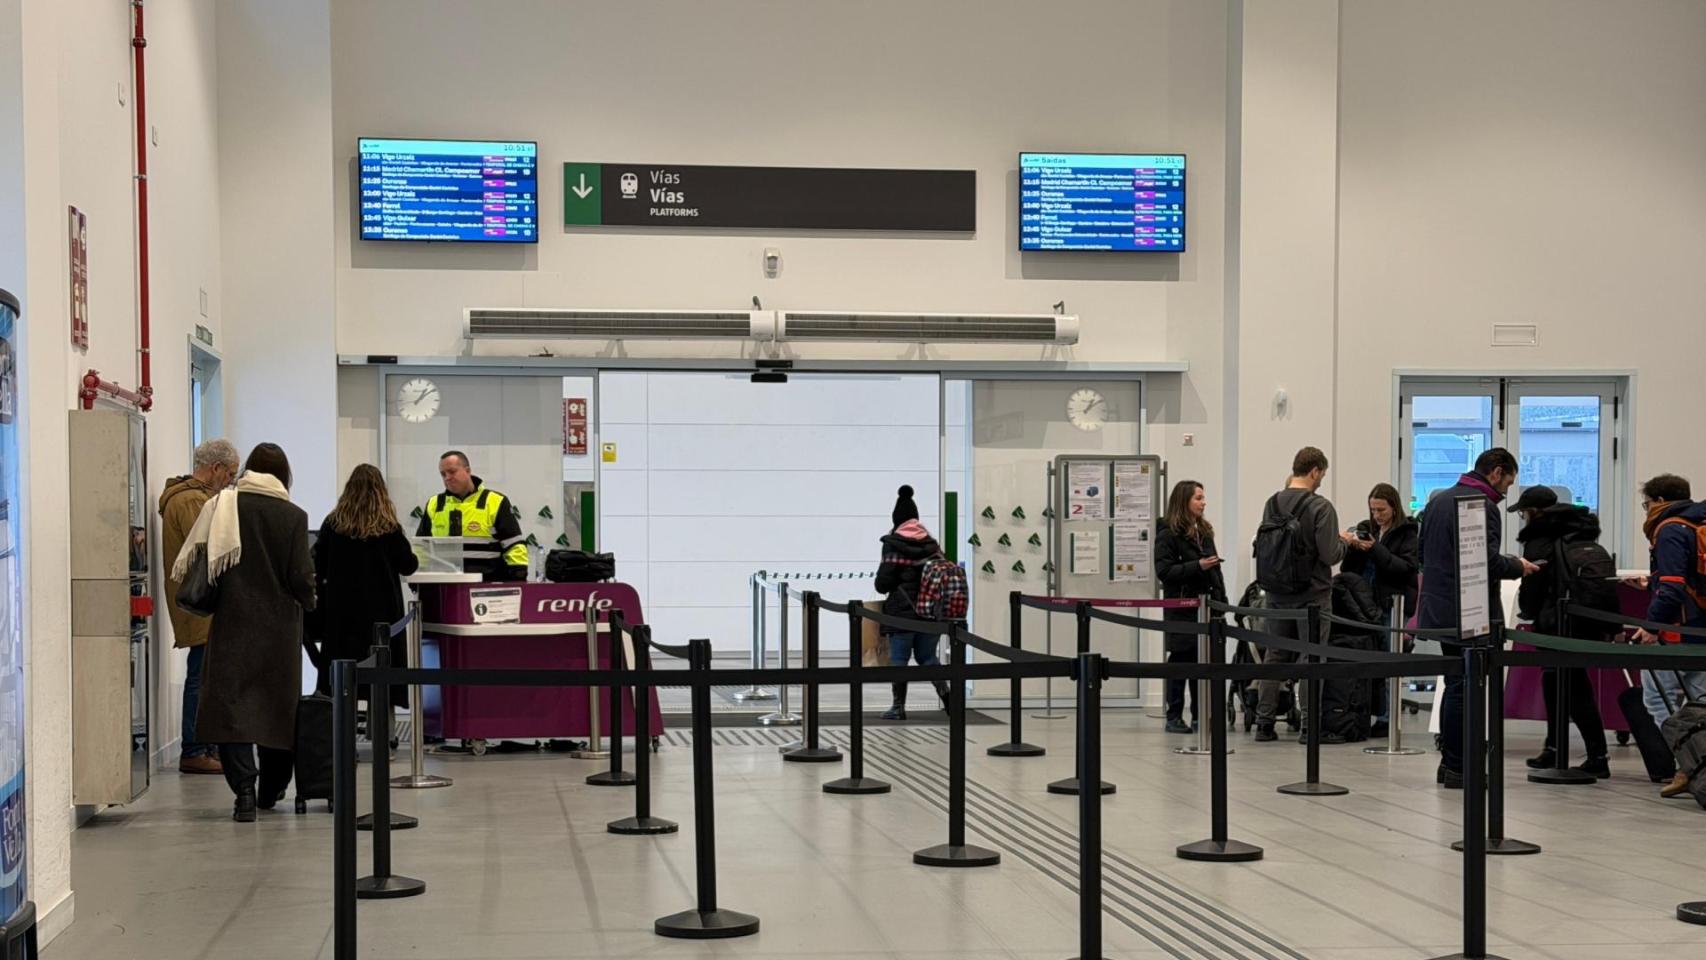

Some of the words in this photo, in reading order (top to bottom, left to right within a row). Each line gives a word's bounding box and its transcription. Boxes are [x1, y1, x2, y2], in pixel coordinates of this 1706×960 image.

[504, 144, 525, 152] 10:51
[650, 170, 681, 184] Vías
[382, 190, 396, 198] Vigo
[650, 187, 685, 203] Vías
[650, 207, 699, 217] PLATFORMS
[383, 215, 397, 223] Vigo
[1072, 504, 1083, 515] 2
[537, 590, 613, 613] renfe
